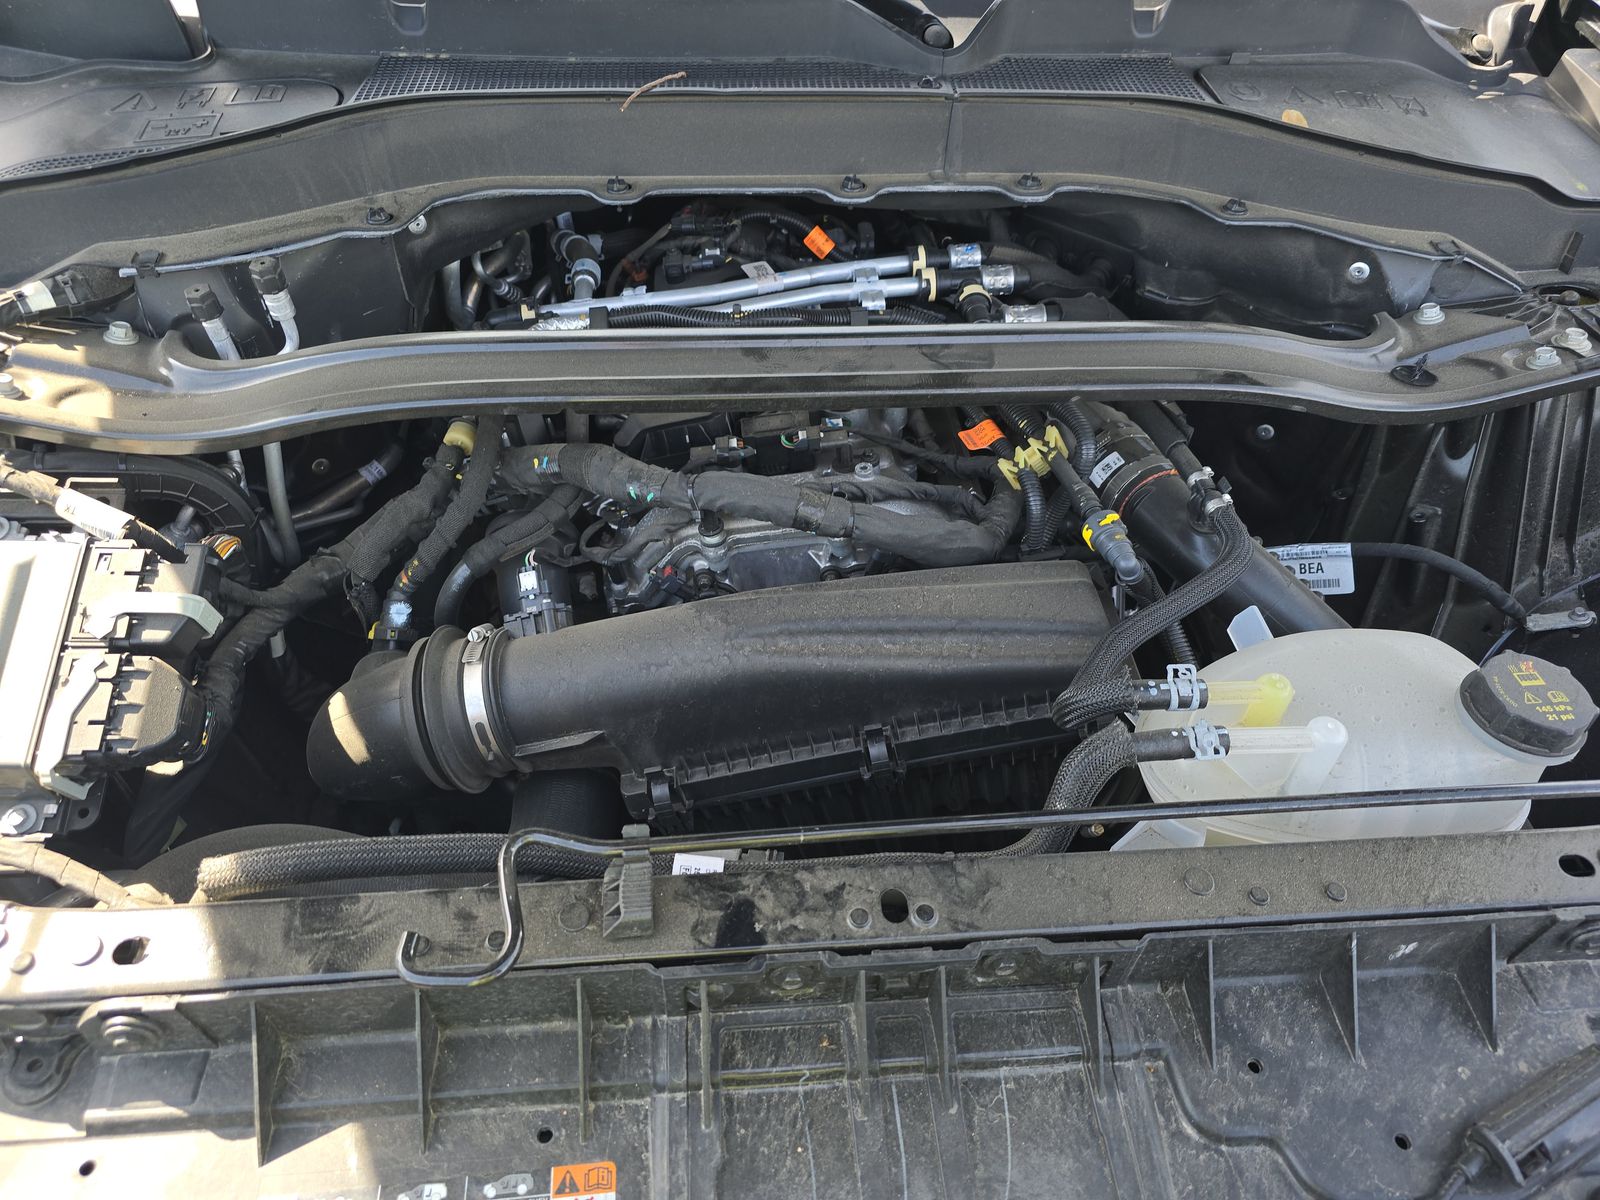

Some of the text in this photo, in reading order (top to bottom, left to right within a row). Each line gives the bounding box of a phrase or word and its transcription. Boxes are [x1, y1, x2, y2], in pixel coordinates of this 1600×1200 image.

[1299, 562, 1325, 575] BEA
[1536, 704, 1574, 713] 145 kPa
[1546, 713, 1575, 721] 21 psi
